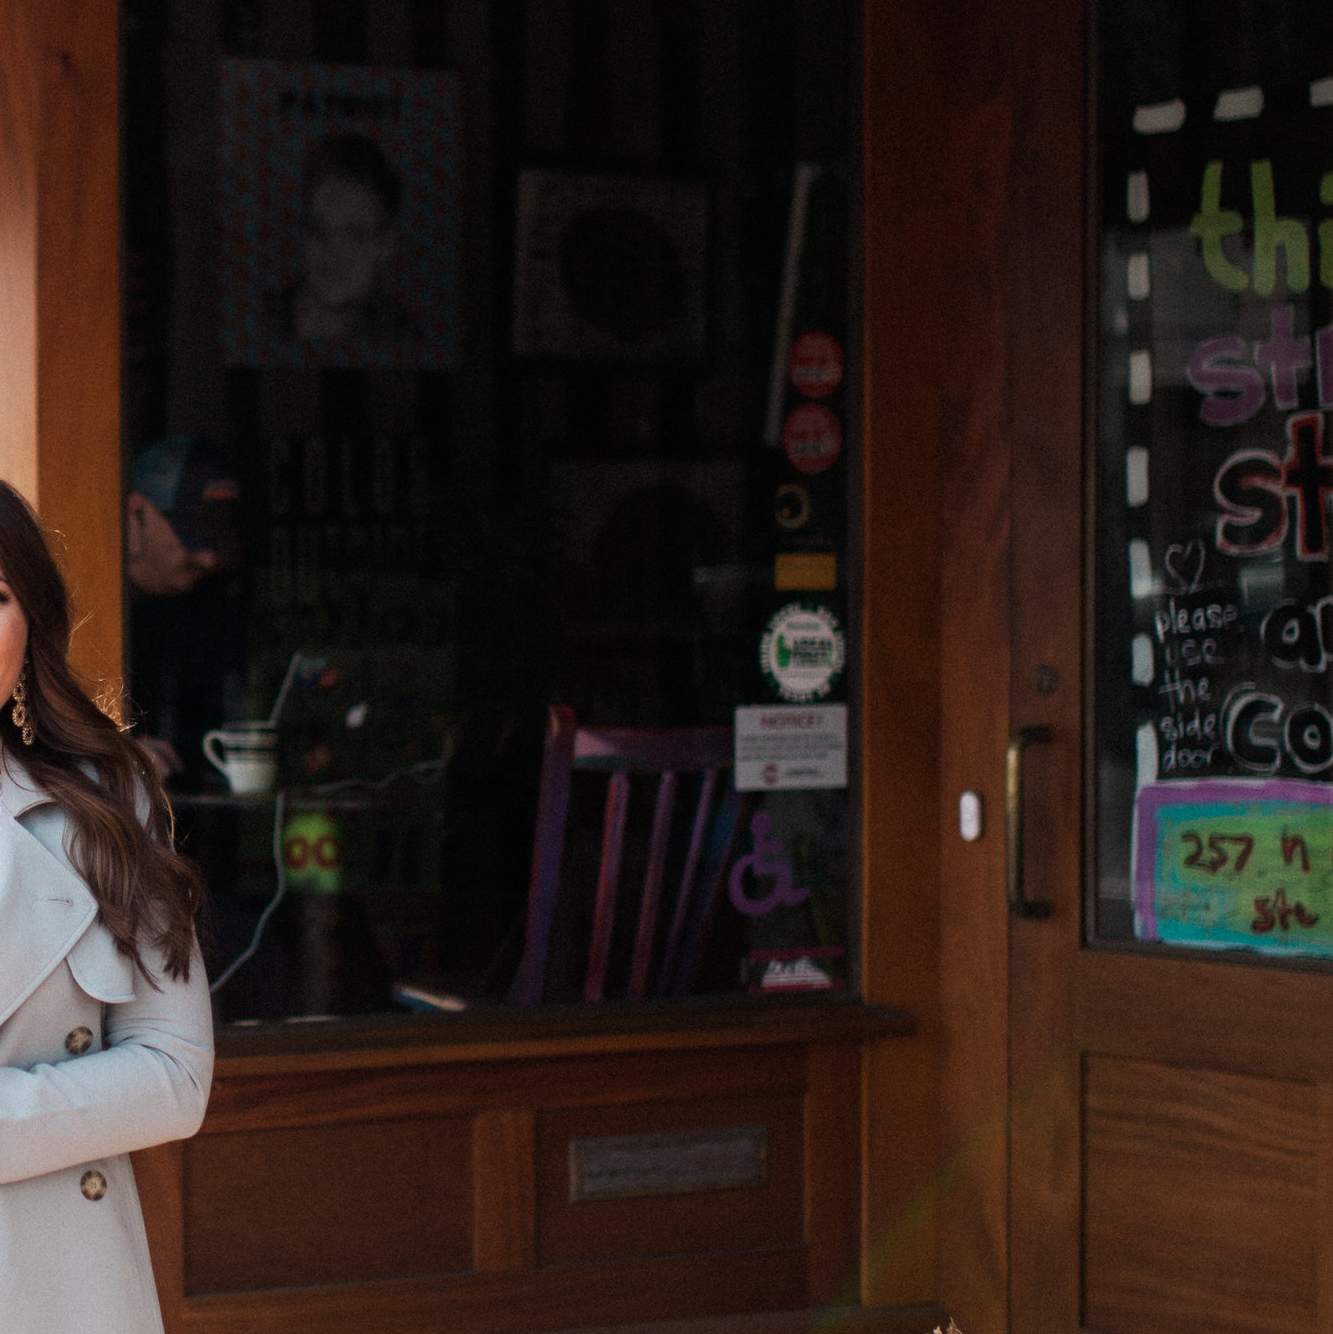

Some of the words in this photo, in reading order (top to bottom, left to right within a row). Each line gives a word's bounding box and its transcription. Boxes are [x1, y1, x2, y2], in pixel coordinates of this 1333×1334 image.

[1154, 597, 1238, 644] please
[1164, 637, 1227, 667] use
[1158, 670, 1211, 713] the
[1159, 707, 1217, 742] side
[1161, 742, 1220, 773] door
[1182, 832, 1253, 874] 257
